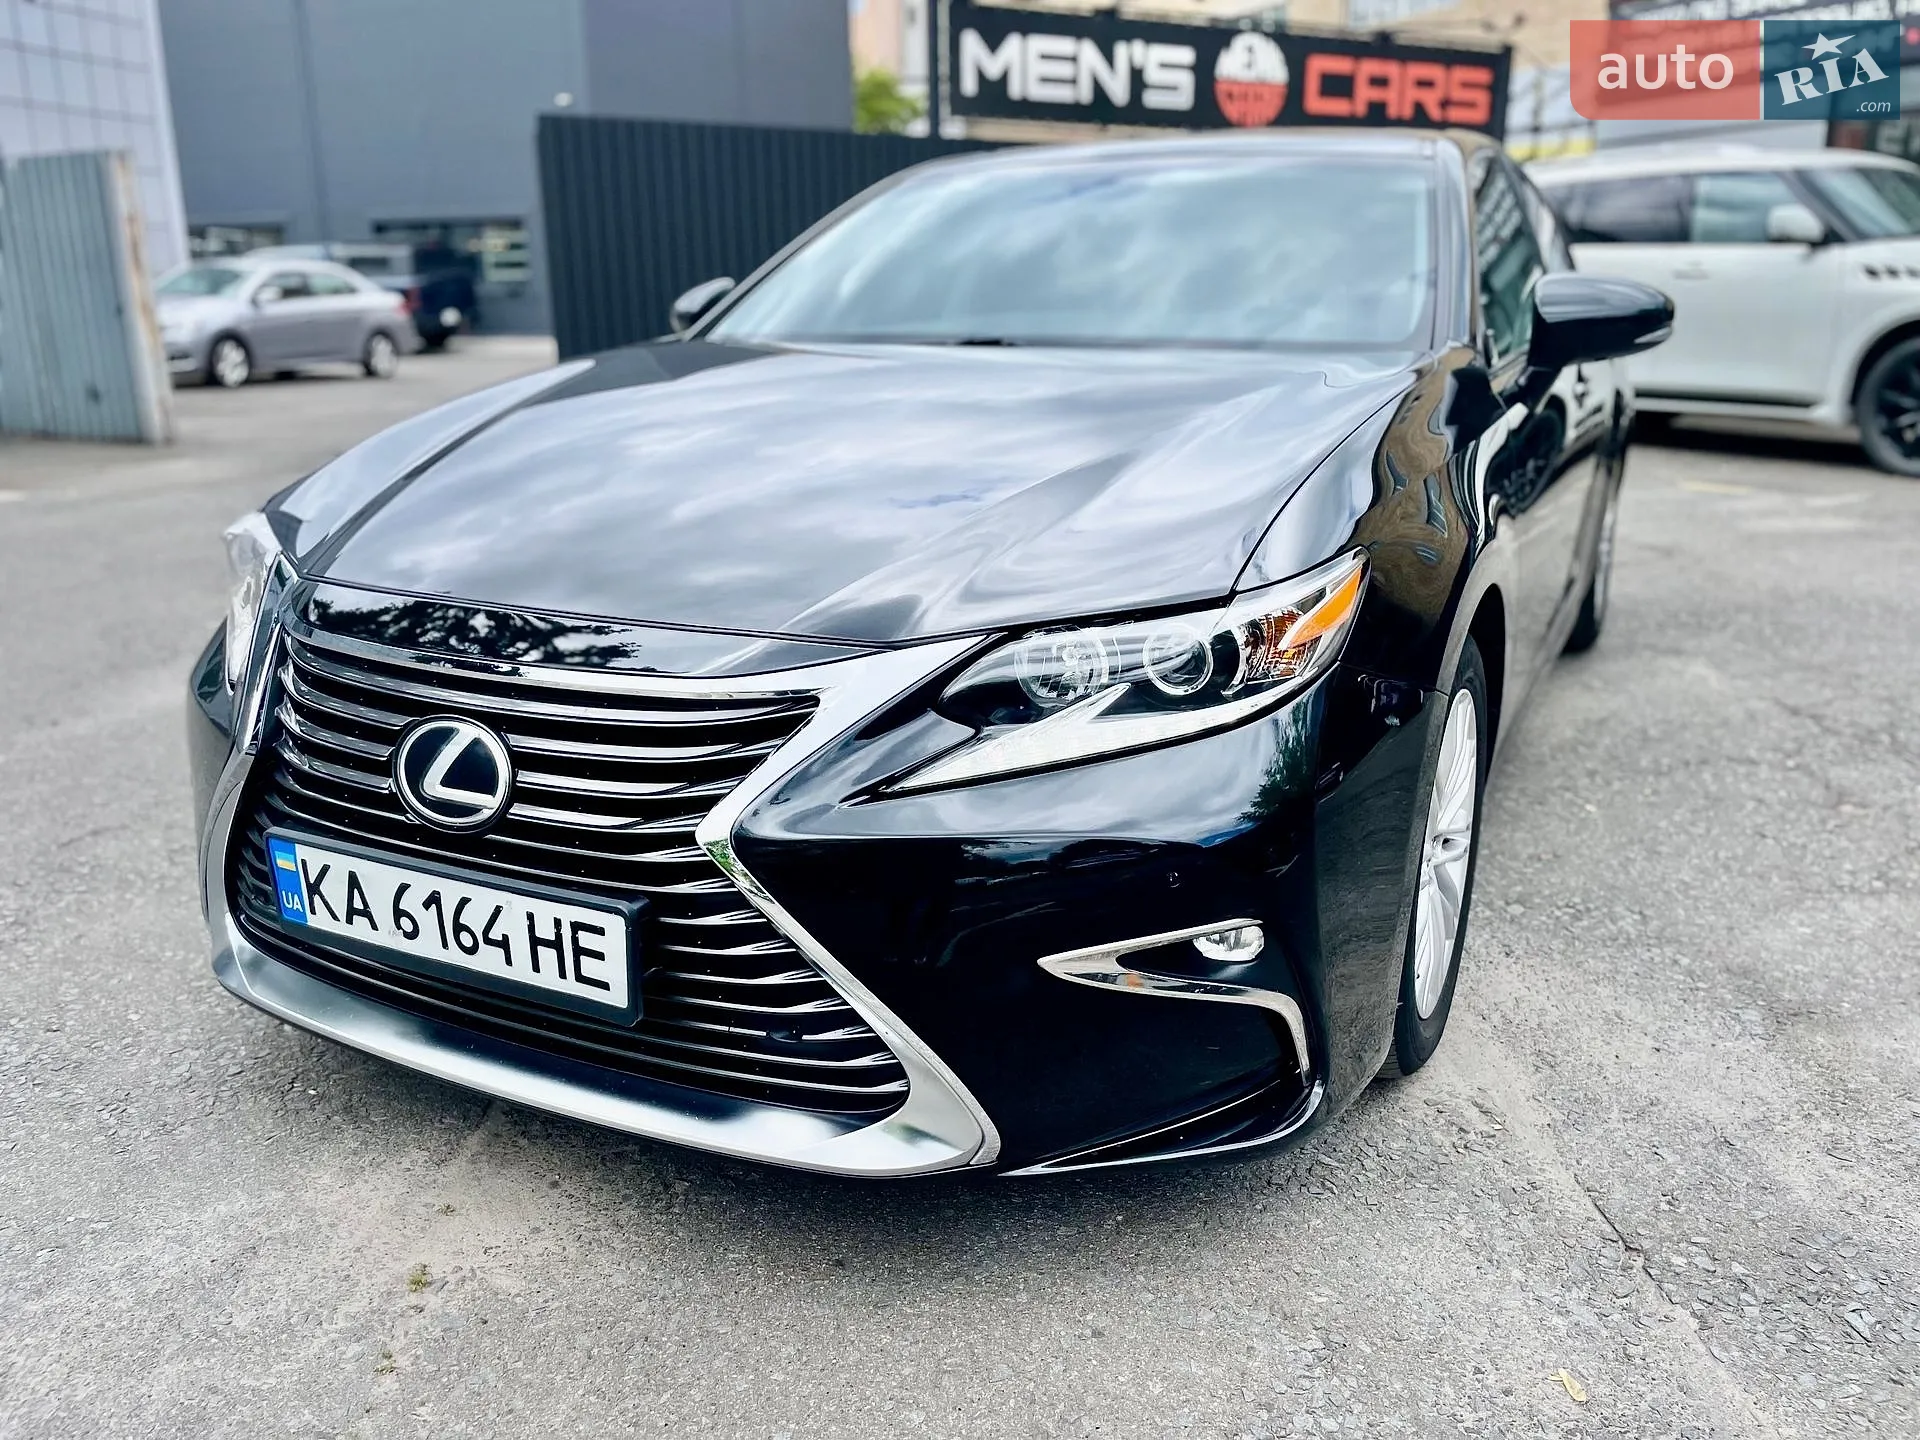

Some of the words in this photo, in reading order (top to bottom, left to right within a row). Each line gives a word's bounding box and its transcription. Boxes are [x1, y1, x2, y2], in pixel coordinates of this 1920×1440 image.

[959, 28, 1196, 111] MEN'S
[1303, 53, 1494, 125] CARS
[281, 890, 303, 913] UA
[300, 858, 379, 932] KA
[392, 882, 513, 967] 6164
[526, 911, 611, 992] HE
